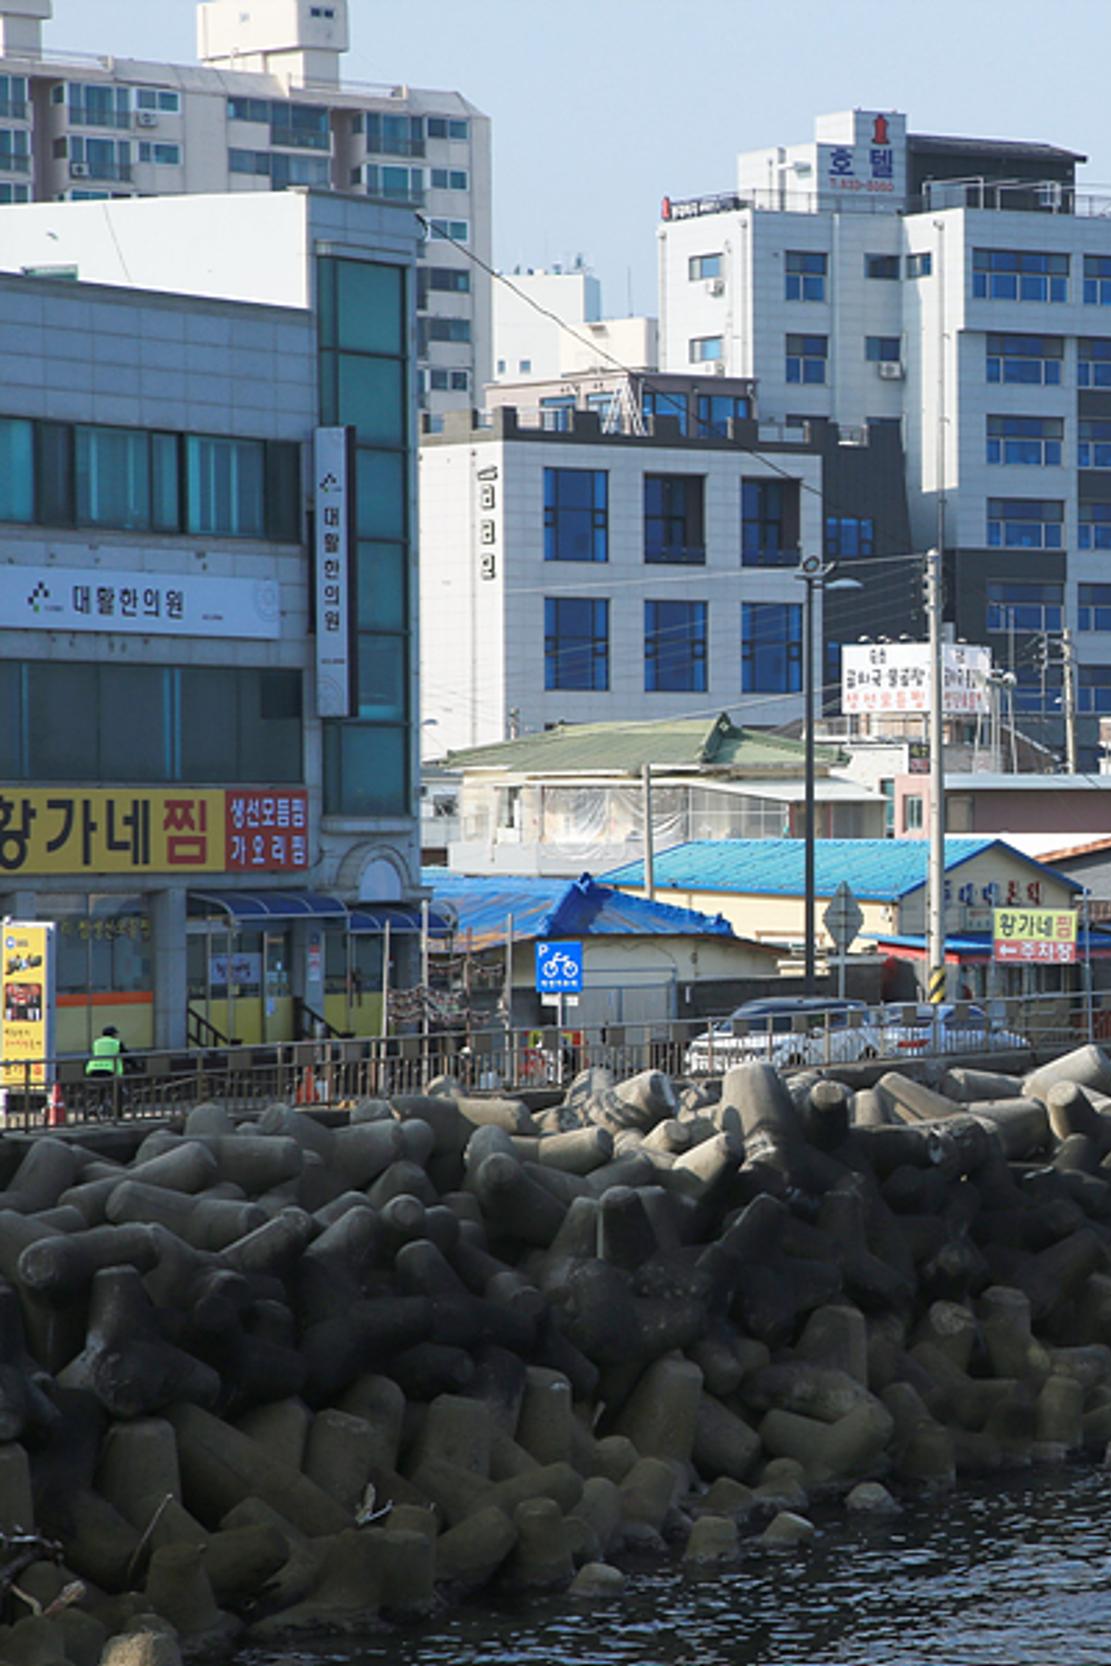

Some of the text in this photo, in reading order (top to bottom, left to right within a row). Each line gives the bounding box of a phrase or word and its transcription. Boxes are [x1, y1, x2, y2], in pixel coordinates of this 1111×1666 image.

[828, 147, 894, 178] 호텔
[72, 585, 184, 620] 대활한의원
[231, 835, 305, 865] 가오리찜
[538, 944, 549, 958] P
[1021, 941, 1073, 962] 주차장
